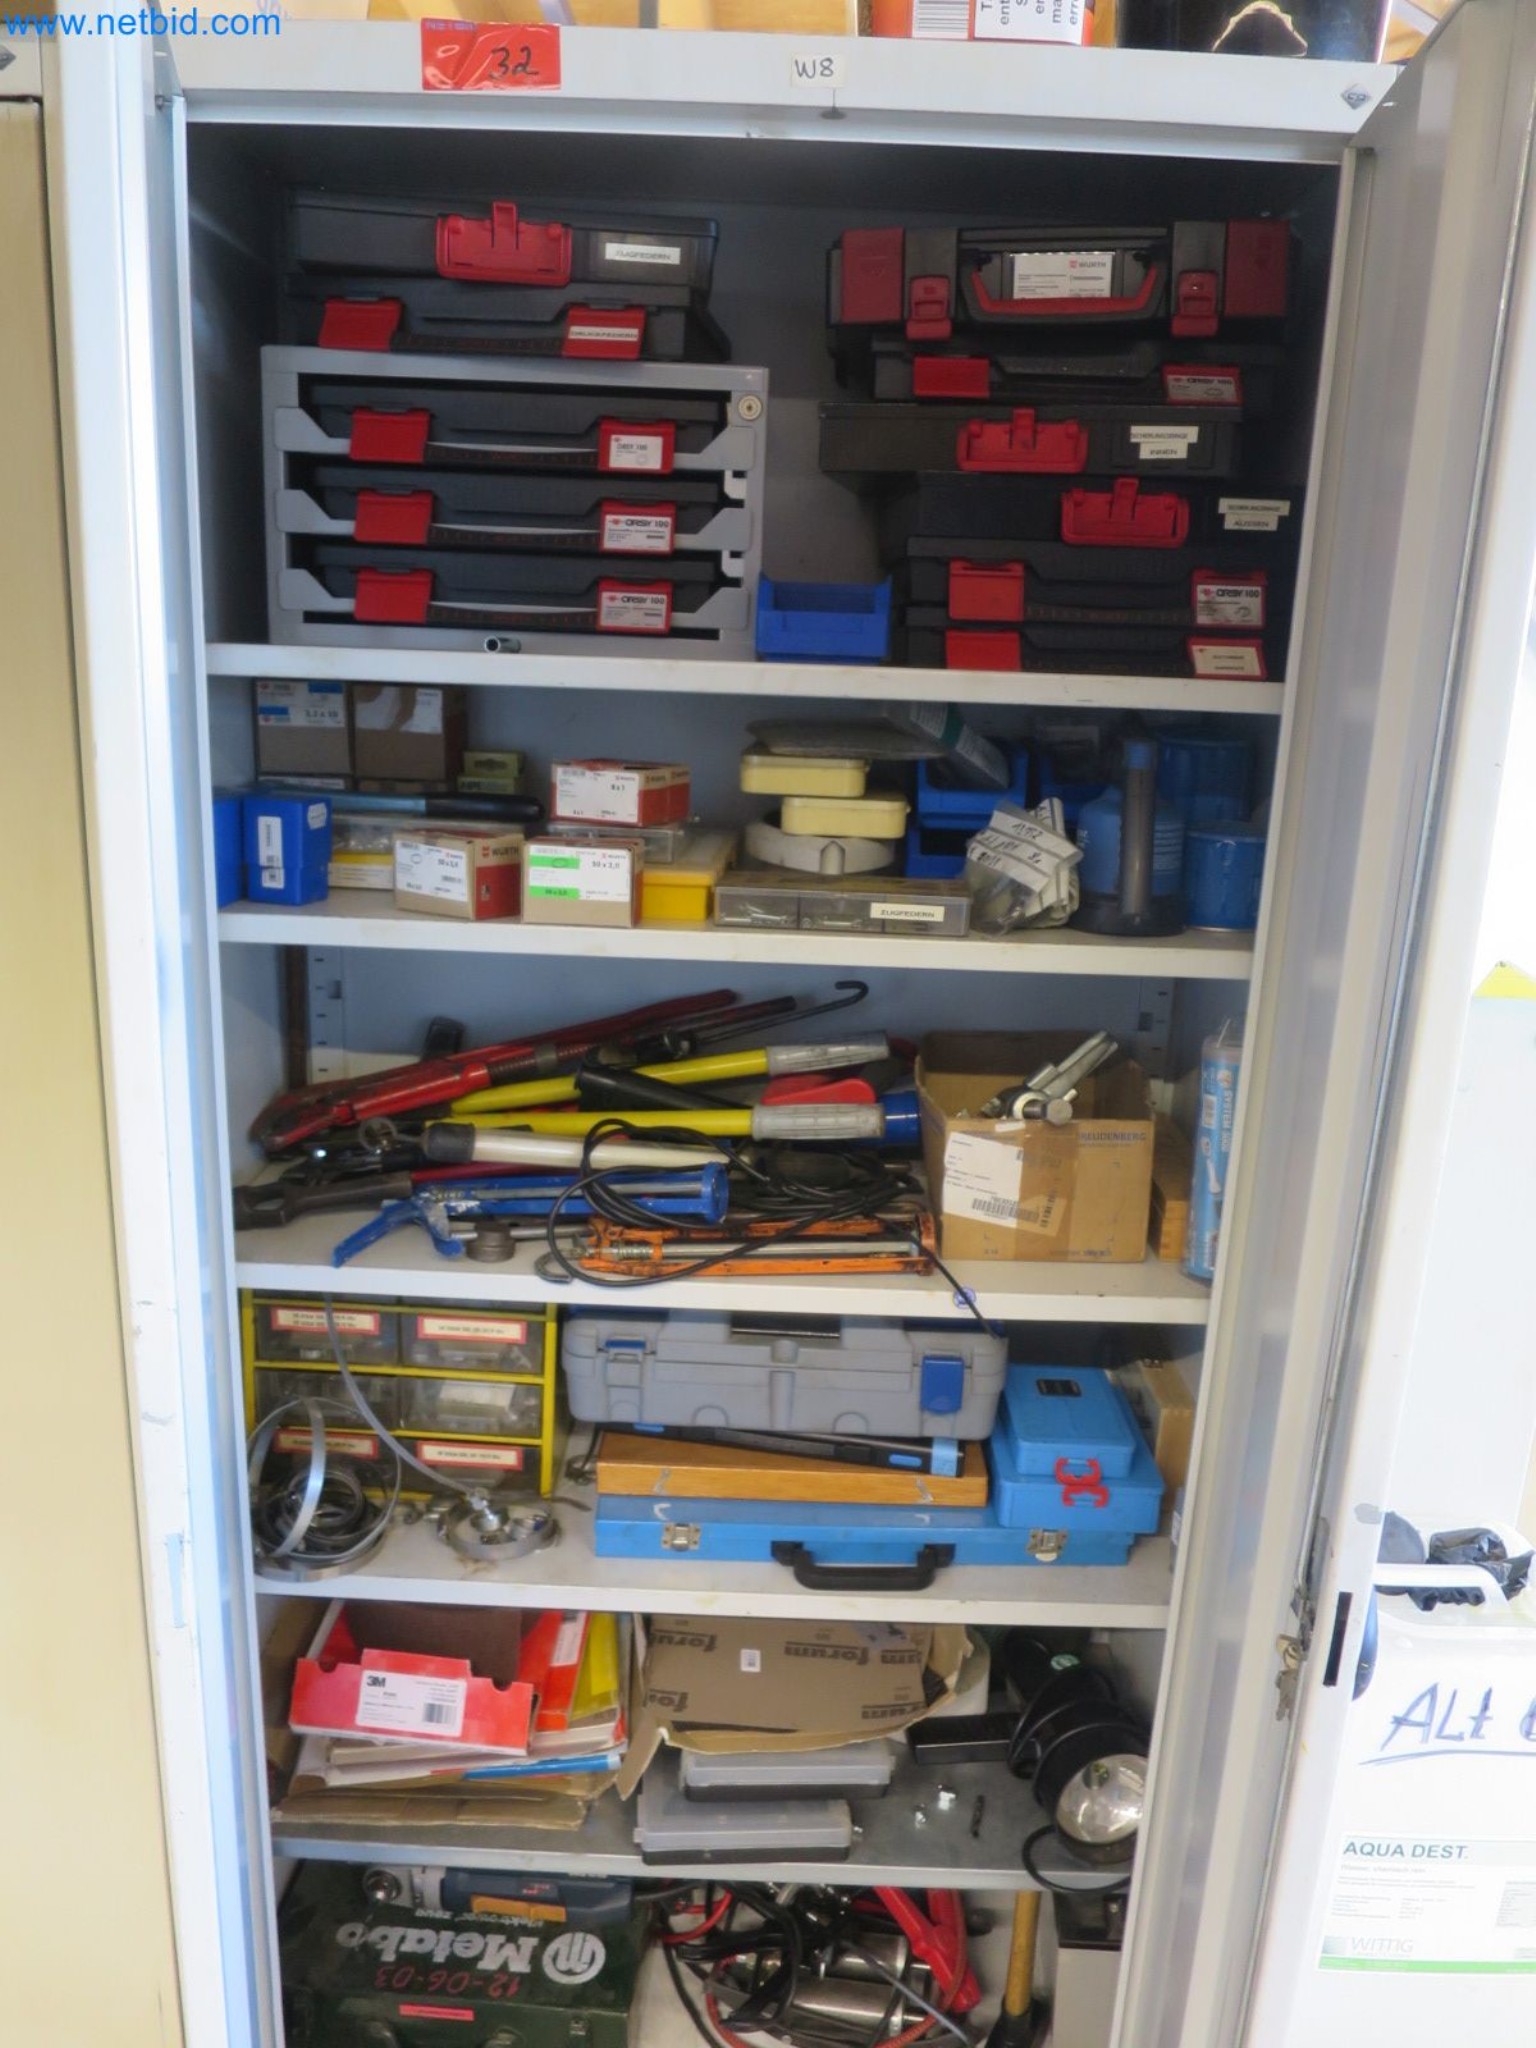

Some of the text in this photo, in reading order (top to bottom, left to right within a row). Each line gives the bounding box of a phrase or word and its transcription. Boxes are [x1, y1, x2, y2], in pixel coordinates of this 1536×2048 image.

[981, 0, 992, 11] T
[1069, 0, 1078, 25] err
[794, 56, 834, 79] W8
[880, 909, 935, 919] ZUGFEDERN
[366, 1675, 386, 1688] 3M
[1343, 1841, 1405, 1858] AQUA
[335, 1921, 540, 1974] Metabo
